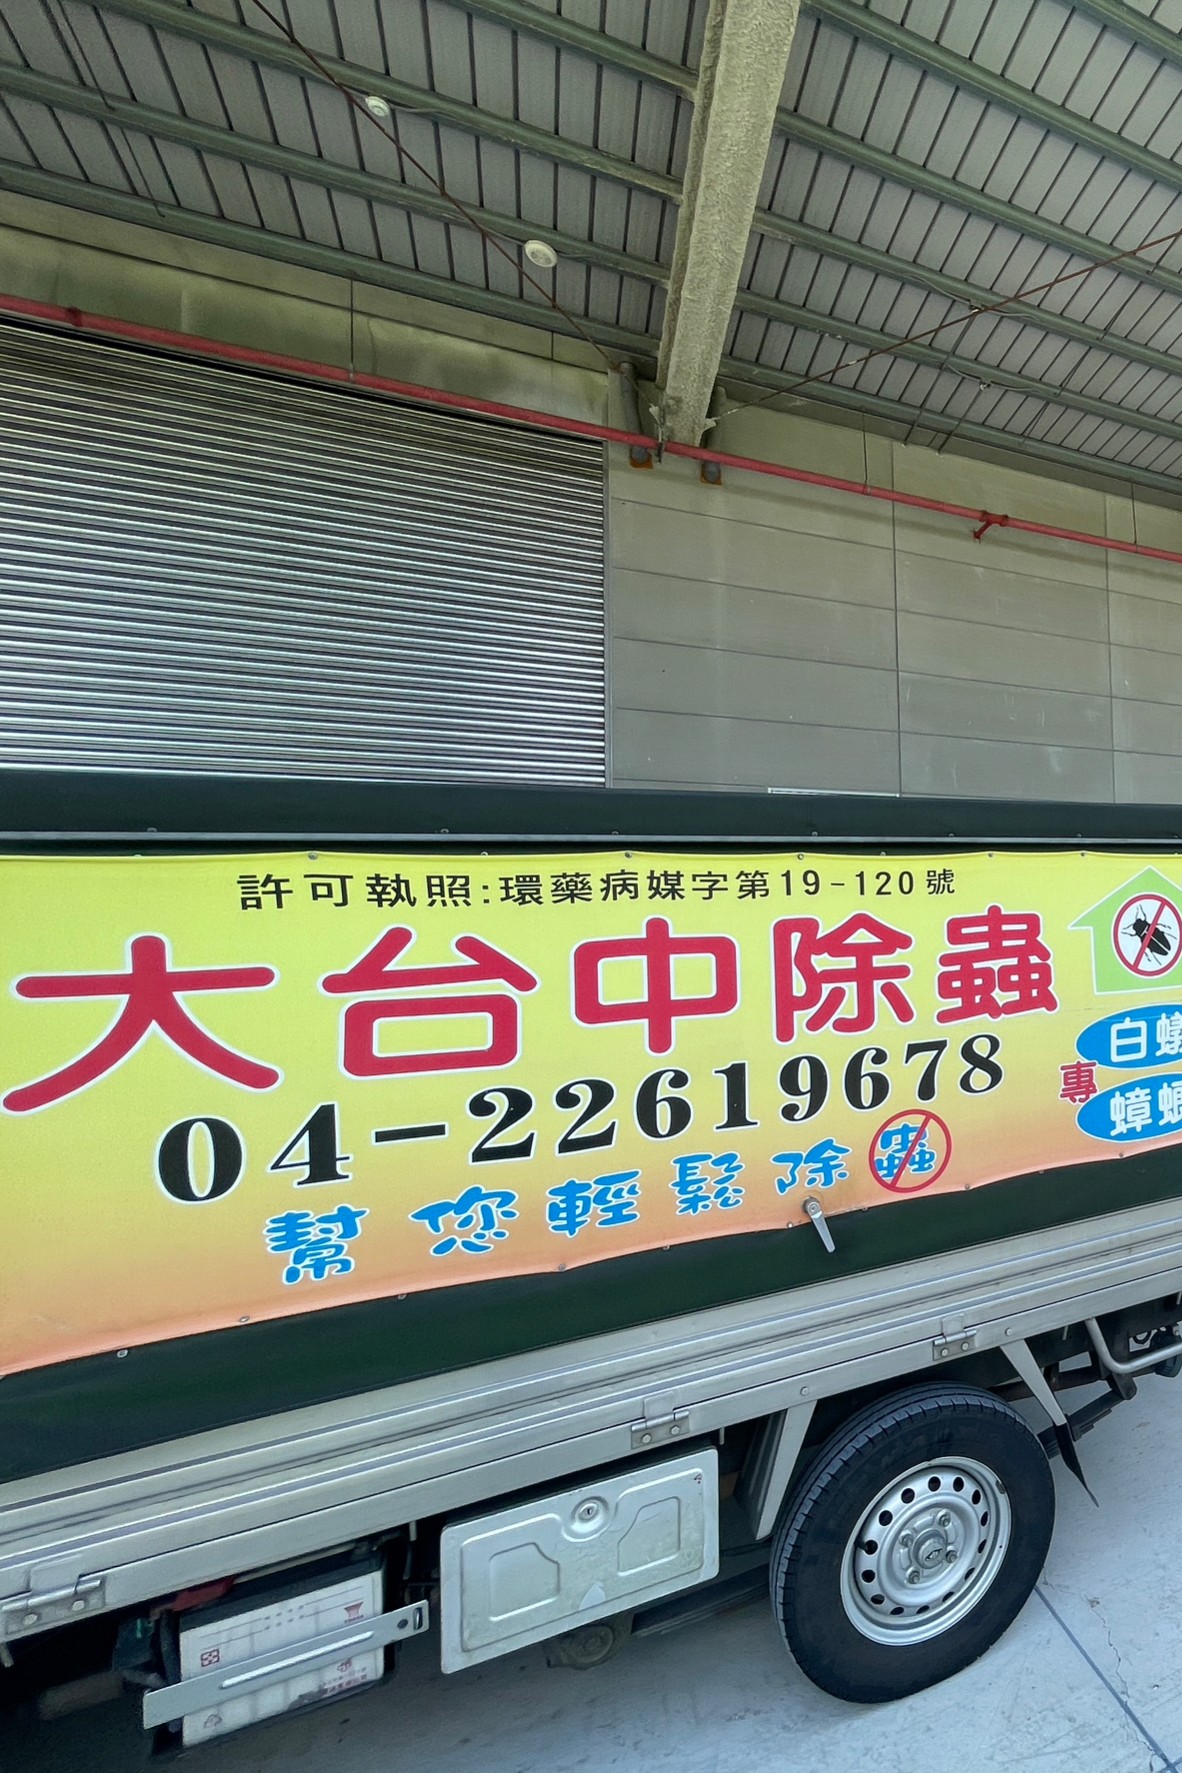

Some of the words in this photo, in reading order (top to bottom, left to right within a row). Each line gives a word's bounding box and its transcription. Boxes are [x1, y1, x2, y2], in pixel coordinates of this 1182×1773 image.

[237, 869, 956, 909] 許可執照:環藥病媒字第19-120號
[3, 905, 1058, 1111] 大台中除蟲
[1060, 1062, 1097, 1103] 專
[158, 1034, 1002, 1202] 04-22619678
[265, 1123, 934, 1284] 幫您輕鬆除蟲
